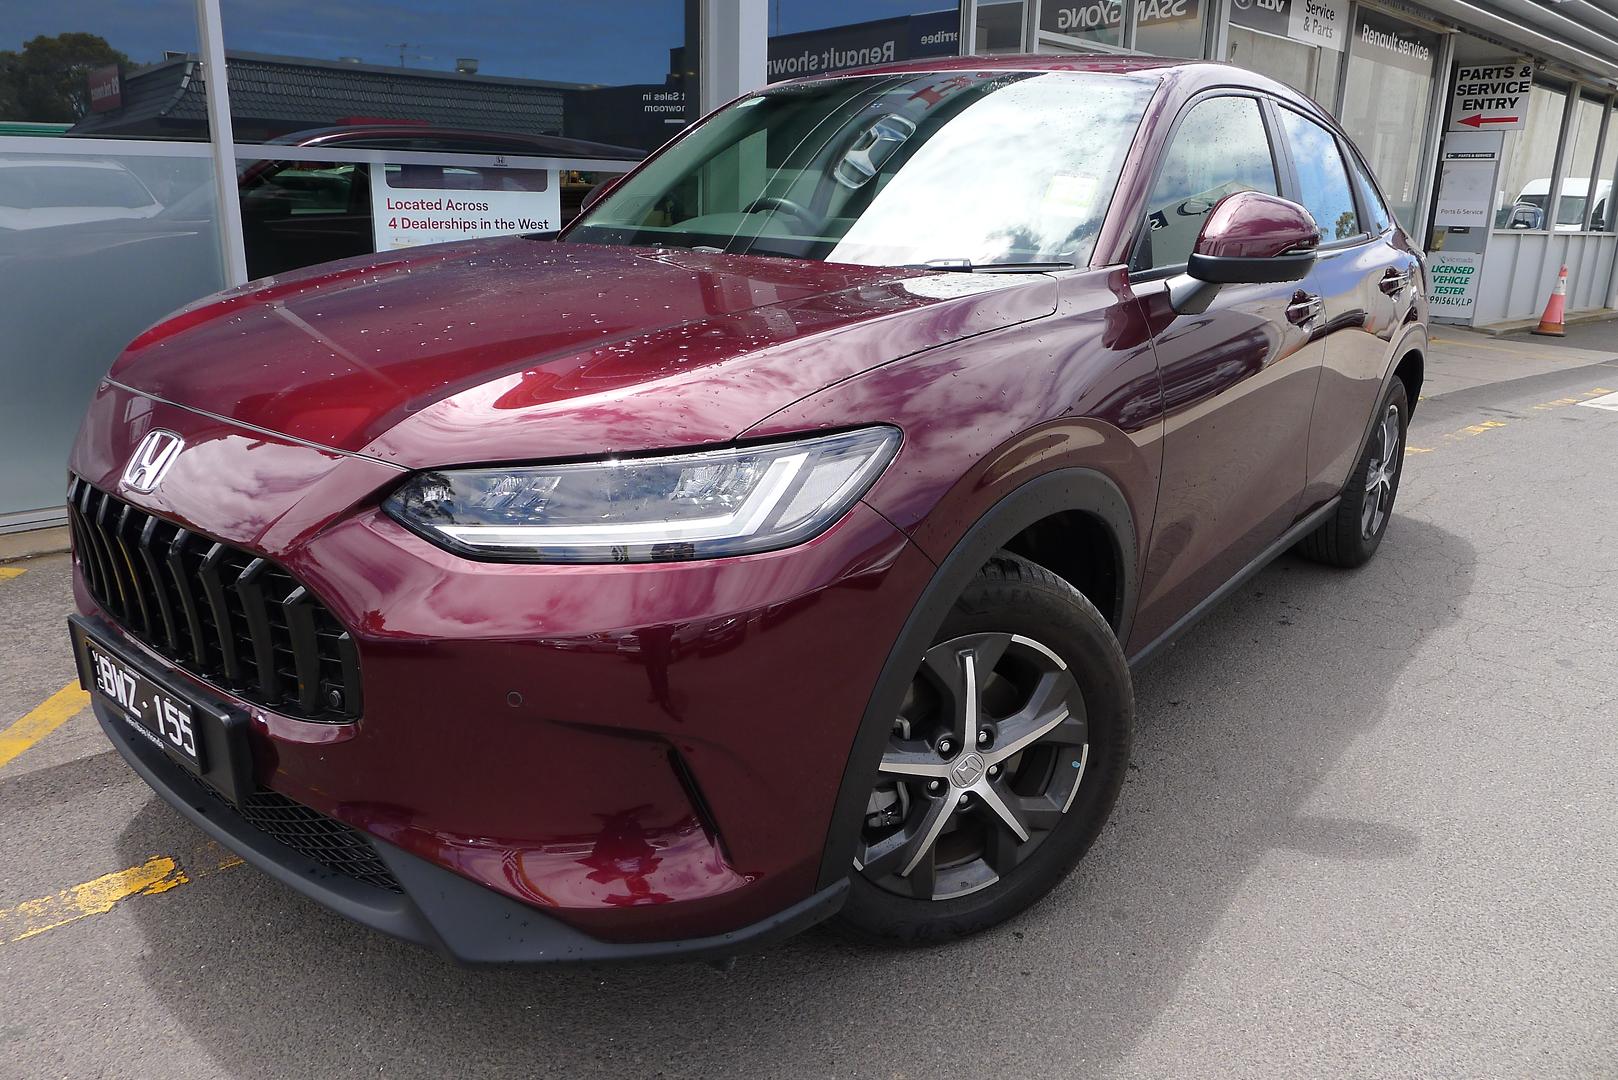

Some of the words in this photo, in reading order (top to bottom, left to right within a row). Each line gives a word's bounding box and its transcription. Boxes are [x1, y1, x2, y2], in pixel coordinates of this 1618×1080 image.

[1305, 0, 1335, 21] Service
[1304, 16, 1310, 32] &
[1312, 19, 1333, 38] Parts
[1362, 23, 1398, 52] Renault
[1398, 40, 1429, 60] service
[1459, 66, 1515, 81] PARTS
[1520, 66, 1531, 77] &
[1456, 81, 1530, 96] SERVICE
[1462, 97, 1519, 110] ENTRY
[387, 198, 442, 211] Located
[446, 199, 489, 212] Across
[388, 217, 398, 229] 4
[401, 217, 477, 232] Dealerships
[480, 218, 491, 230] in
[494, 218, 515, 230] the
[518, 219, 549, 230] West
[1431, 264, 1475, 275] LICENSED
[1433, 275, 1470, 285] VEHICLE
[1434, 286, 1465, 296] TESTER
